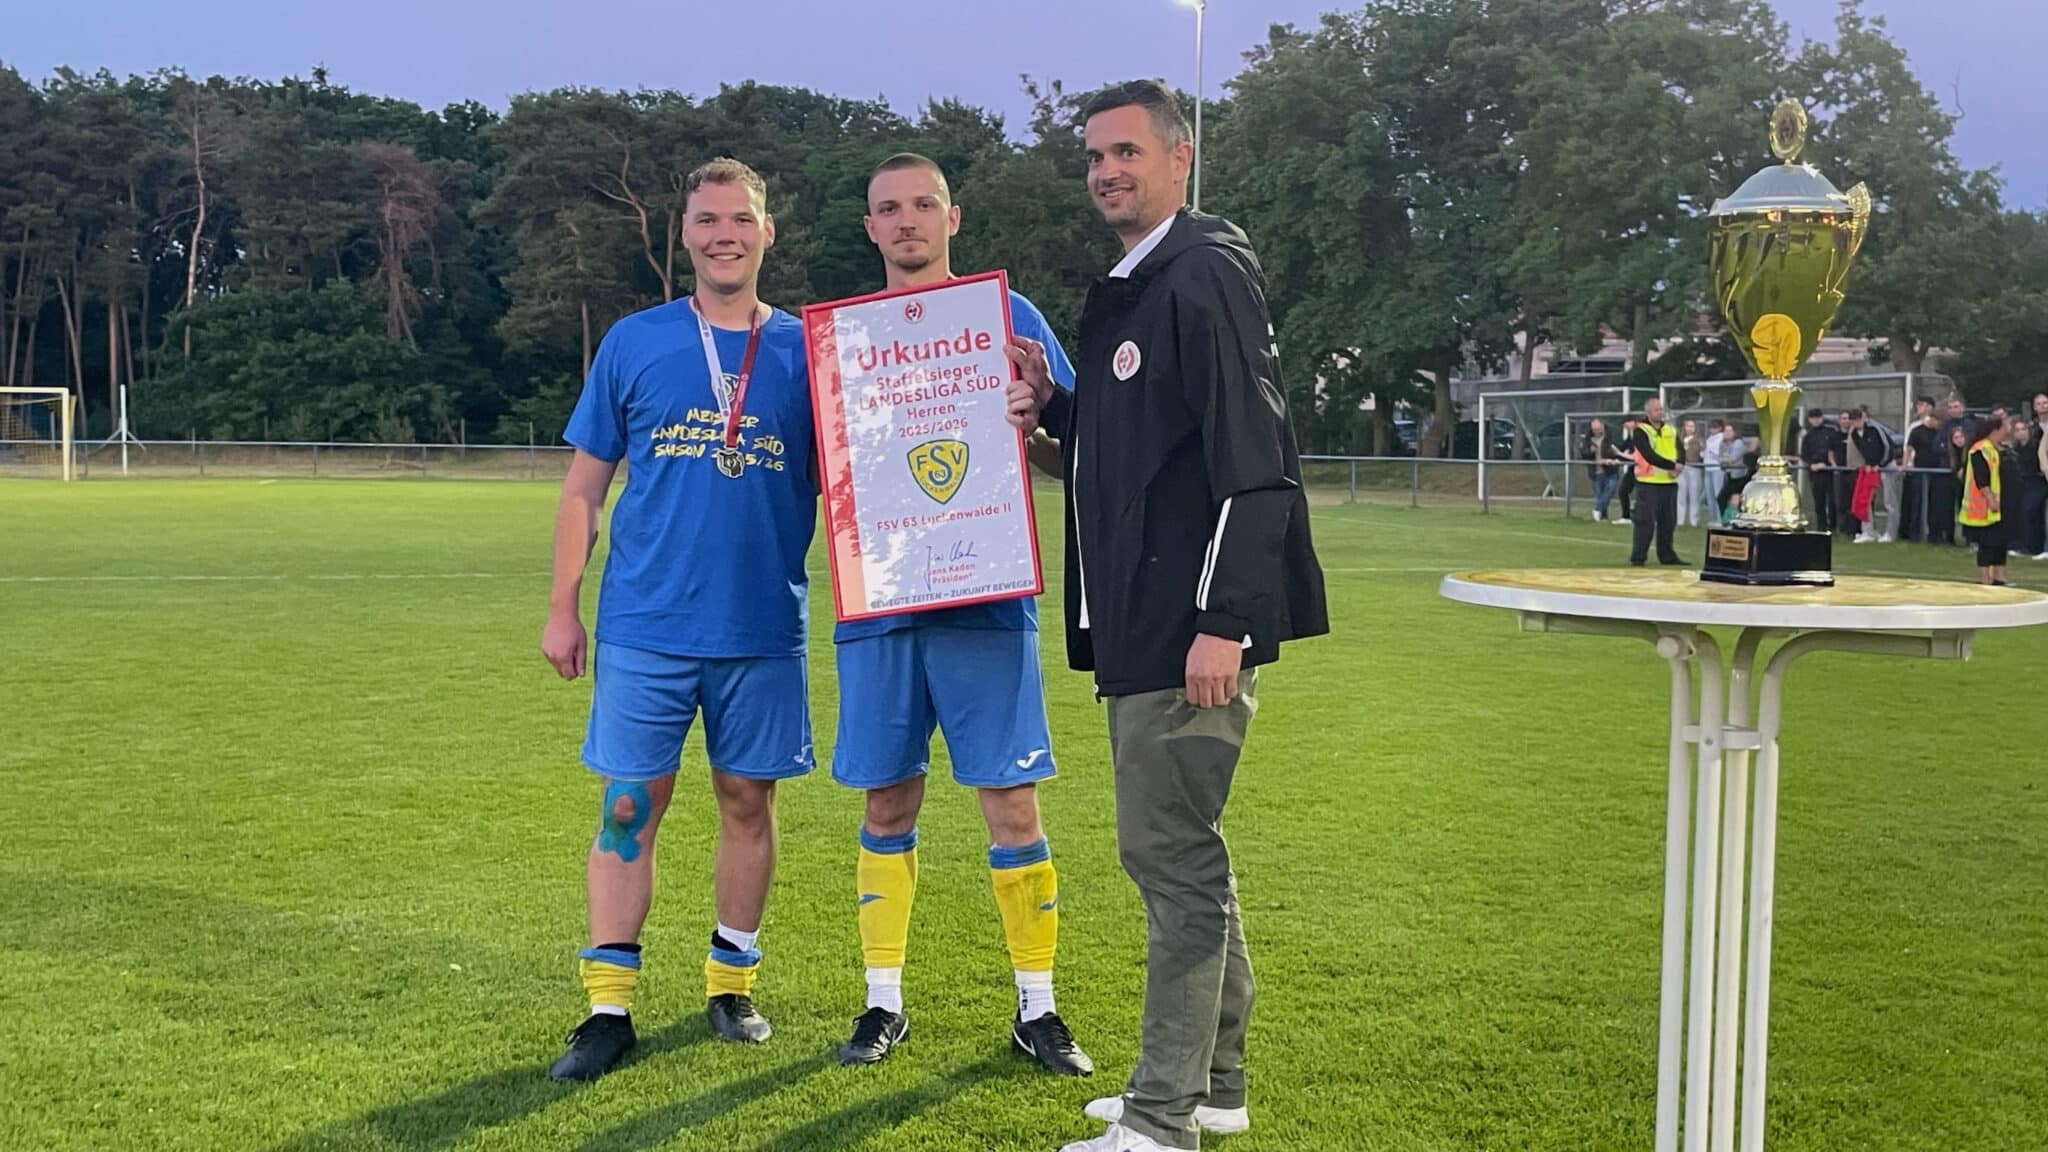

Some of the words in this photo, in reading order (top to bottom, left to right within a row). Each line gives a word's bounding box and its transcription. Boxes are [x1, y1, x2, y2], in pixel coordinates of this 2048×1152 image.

[856, 328, 991, 371] Urkunde
[876, 363, 979, 390] Staffelsieger
[859, 382, 961, 410] LANDESLIGA
[967, 375, 1001, 394] SÜD
[686, 408, 759, 428] MEISER
[907, 403, 956, 420] Herren
[650, 423, 747, 447] LANDESLIA
[752, 434, 785, 456] SÜD
[899, 417, 968, 438] 2025/2026
[710, 447, 785, 472] 25/26
[877, 518, 899, 533] FSV
[902, 515, 918, 529] 63
[948, 563, 976, 574] Kaden
[911, 592, 943, 604] ZEITEN
[950, 586, 992, 599] ZUKUNFT
[993, 580, 1035, 593] BEWEGEN
